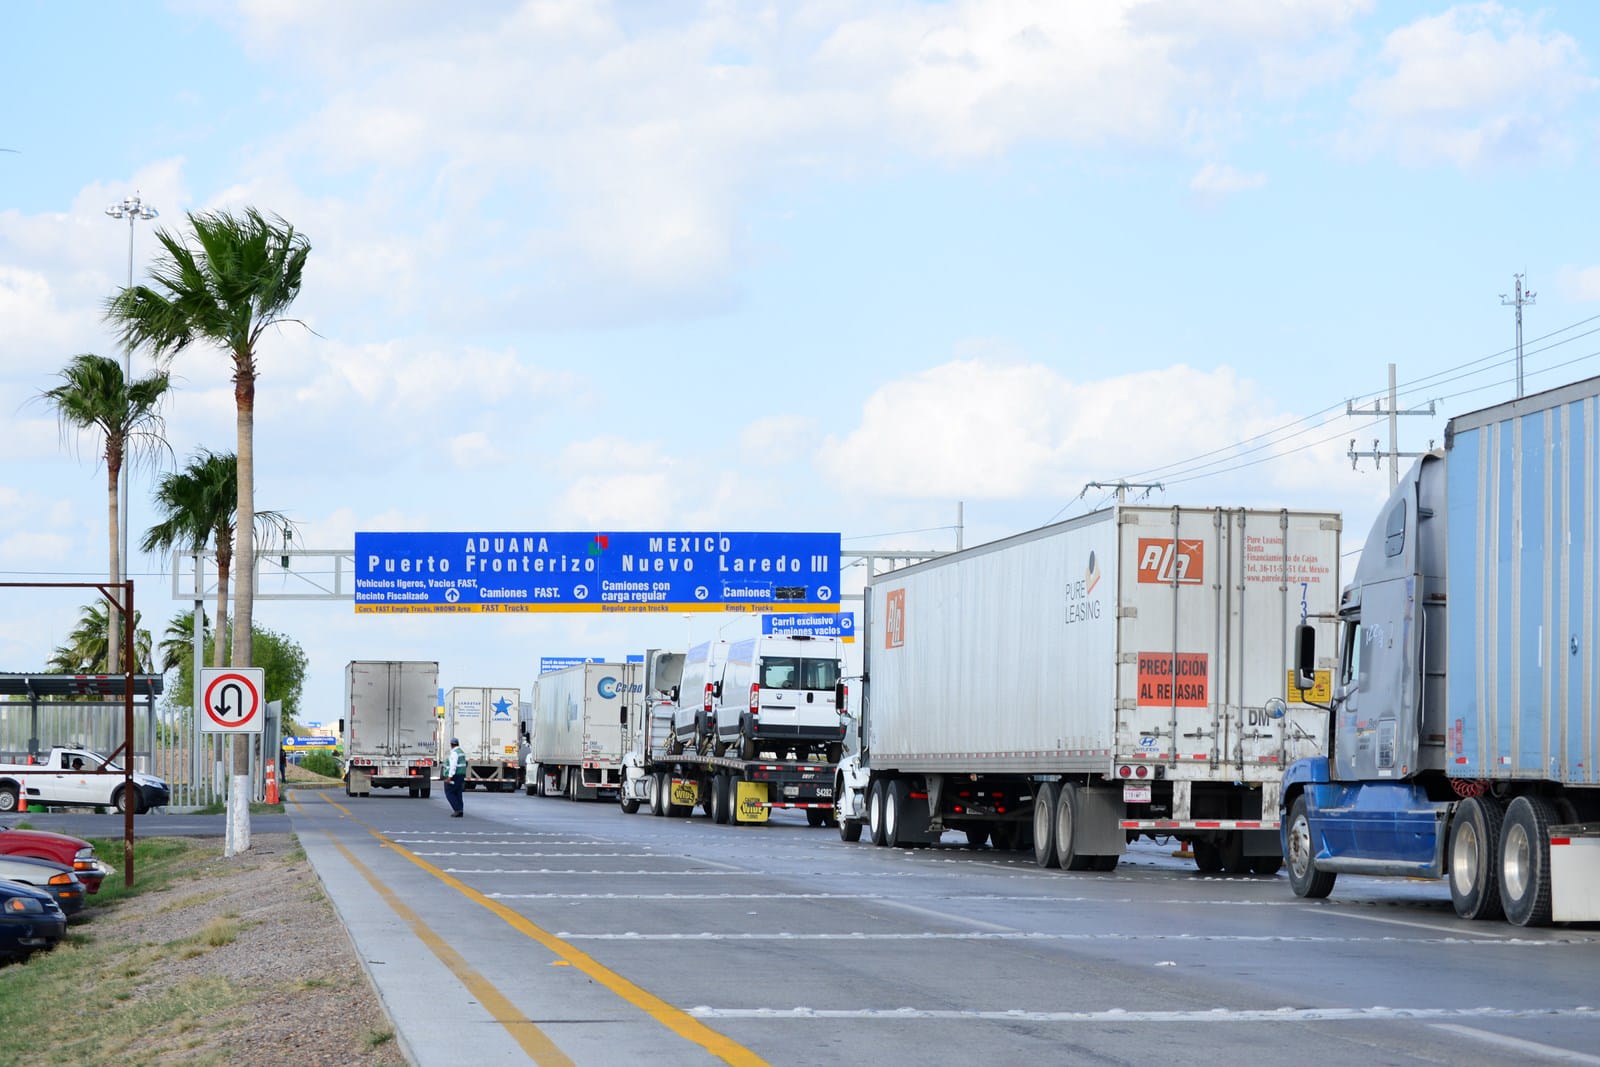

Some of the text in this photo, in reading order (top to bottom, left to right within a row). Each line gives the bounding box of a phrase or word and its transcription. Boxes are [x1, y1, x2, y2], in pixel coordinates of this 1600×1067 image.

[465, 537, 731, 553] ADUANA MEXICO
[368, 554, 828, 573] Puerto Fronterizo Nuevo Laredo III
[1139, 543, 1201, 582] ALA
[1246, 554, 1291, 562] Financiamieto
[1293, 554, 1300, 562] de
[457, 579, 478, 589] FAST,
[602, 580, 671, 591] Camiones con
[356, 592, 429, 600] Recinto Fiscalizado
[480, 587, 560, 598] Camiones FAST.
[723, 587, 771, 597] Camiones
[1065, 580, 1086, 601] PURE
[601, 590, 667, 603] carga regular
[481, 604, 529, 612] FAST Trucks
[601, 604, 626, 613] Regular
[628, 605, 647, 613] cargo
[725, 604, 746, 612] Empty
[1065, 600, 1101, 624] LEASING
[771, 616, 834, 626] Carril exclusivo
[1140, 683, 1153, 699] AL
